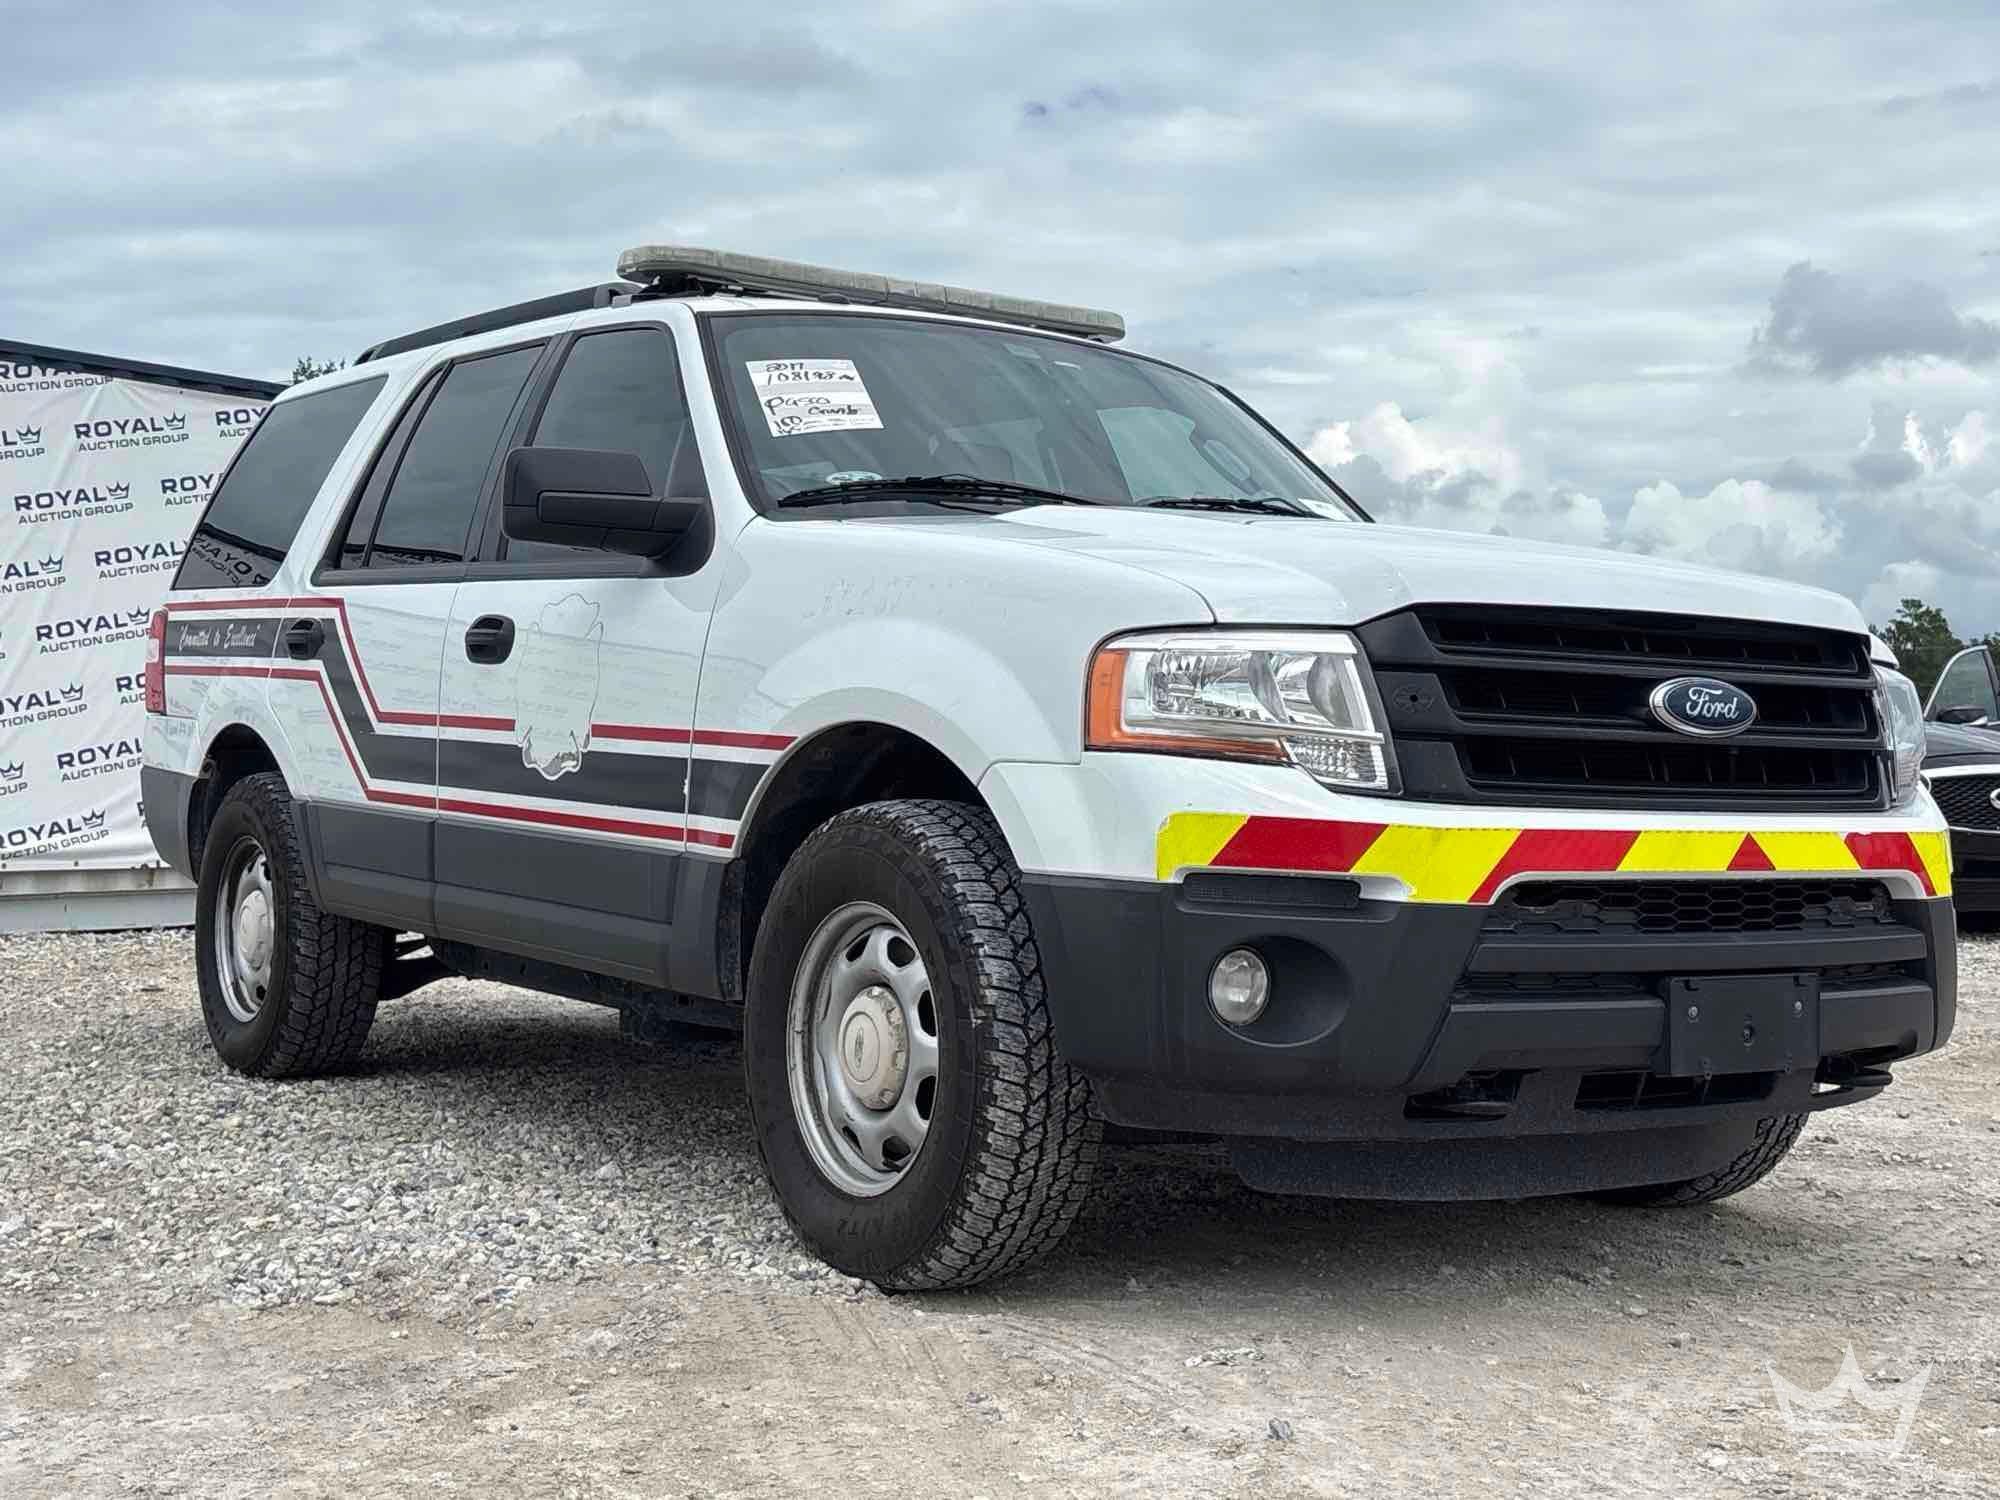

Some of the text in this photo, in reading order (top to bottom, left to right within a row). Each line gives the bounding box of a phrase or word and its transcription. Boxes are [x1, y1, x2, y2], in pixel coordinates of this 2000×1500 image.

[215, 407, 267, 426] ROY
[74, 417, 164, 440] ROYAL
[219, 427, 252, 439] AUCT
[78, 433, 190, 452] AUCTION GROUP
[161, 473, 222, 494] ROY
[14, 486, 107, 511] ROYAL
[164, 492, 214, 507] AUCTIO
[18, 502, 134, 525] AUCTION GROUP
[94, 541, 184, 567] ROYAL
[98, 562, 160, 580] AUCTION
[15, 575, 66, 592] GROUP
[36, 613, 128, 641] ROYAL
[40, 635, 103, 655] AUCTION
[0, 690, 61, 715] YAL
[1685, 686, 1740, 719] Ford
[0, 703, 88, 729] TION GROUP
[61, 759, 124, 783] AUCTION
[0, 782, 28, 797] OUP
[1, 829, 110, 861] UCTION GROUP
